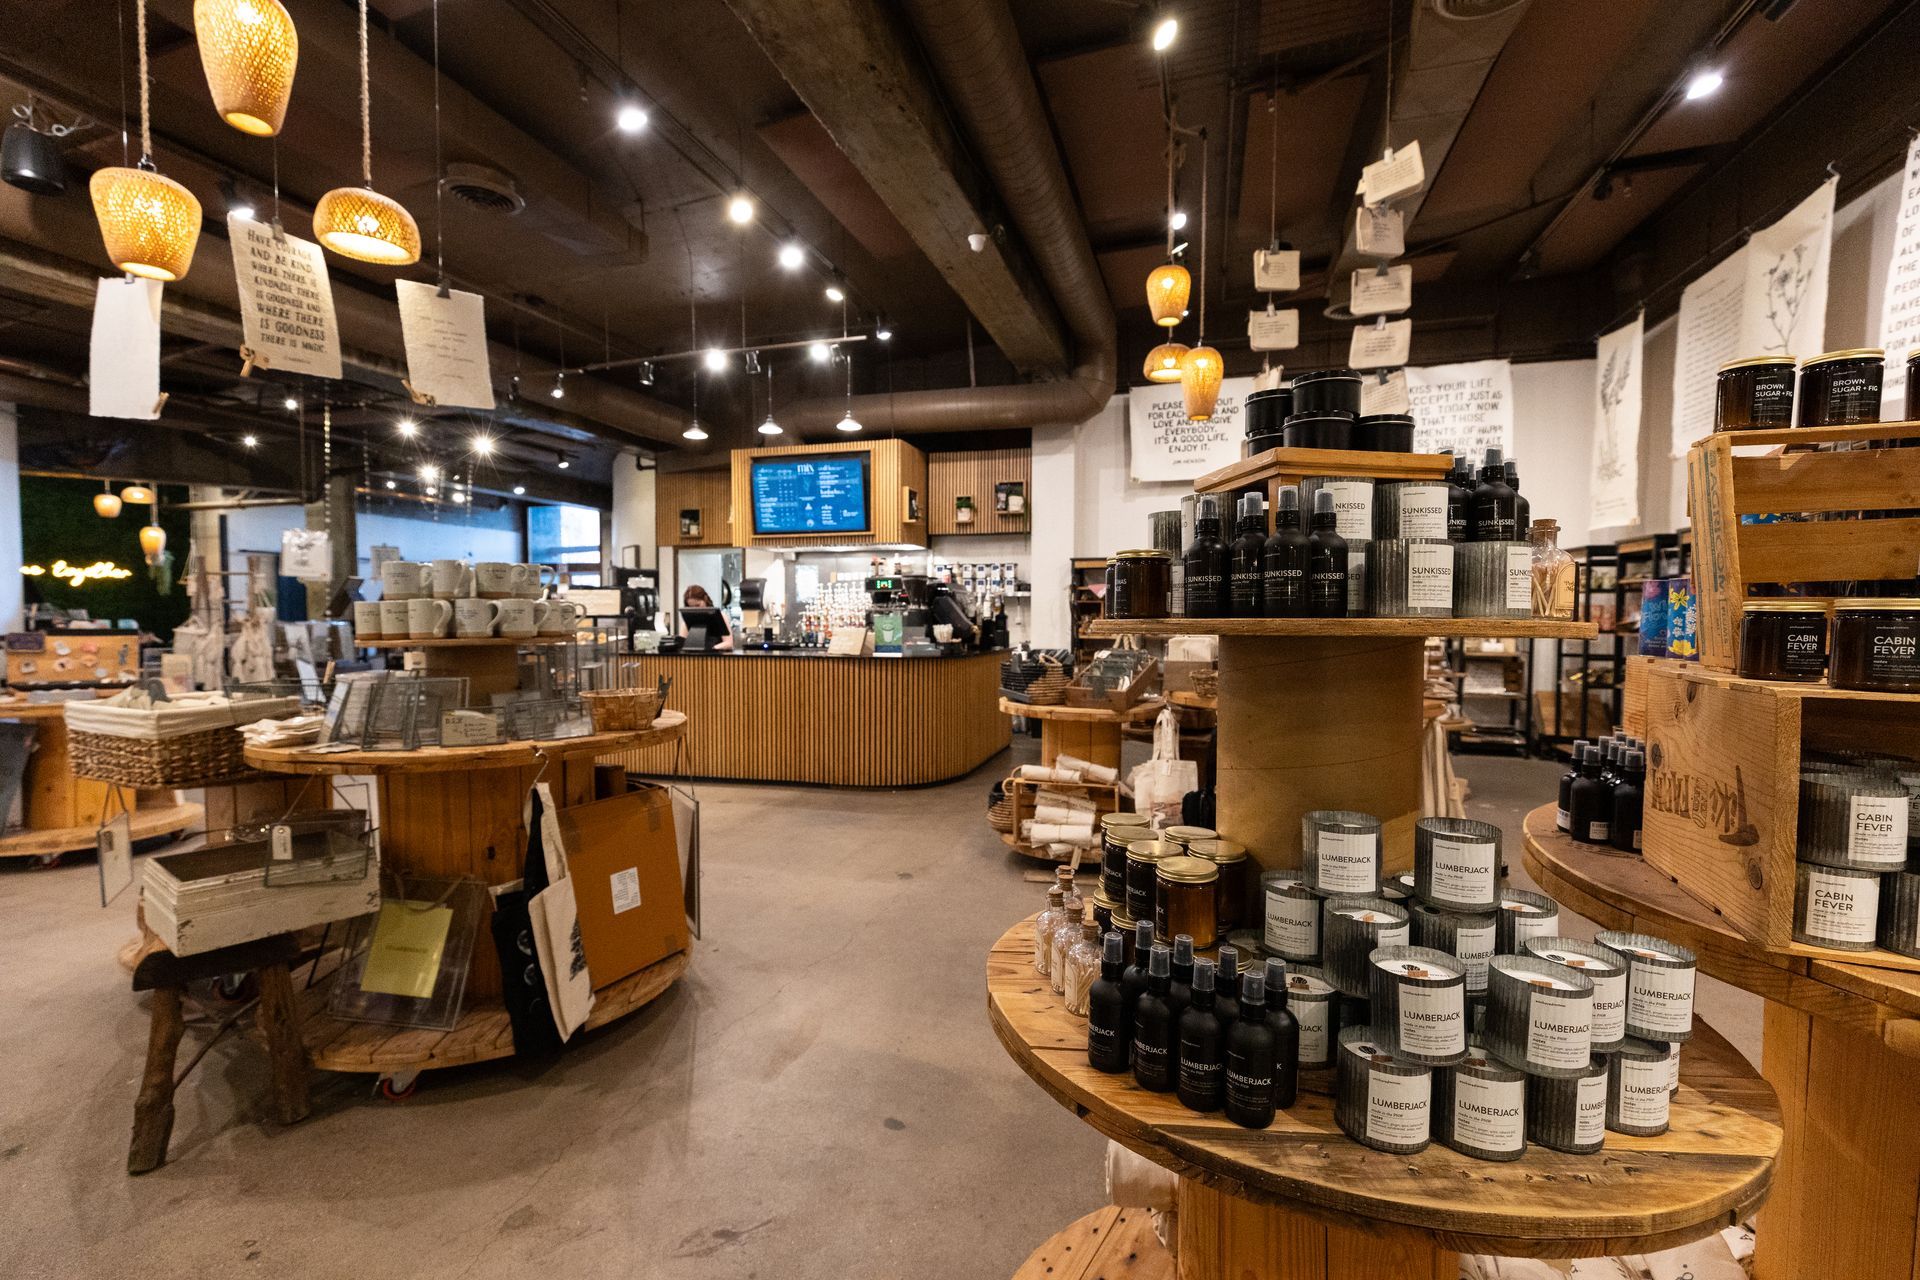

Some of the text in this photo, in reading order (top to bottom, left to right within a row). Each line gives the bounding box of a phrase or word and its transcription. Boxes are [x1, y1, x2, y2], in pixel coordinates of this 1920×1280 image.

[250, 248, 271, 261] AND
[275, 254, 286, 266] BE
[252, 262, 277, 277] WHERE
[282, 270, 305, 284] THERE
[296, 287, 320, 300] THERE
[256, 289, 320, 313] IS GOODNESS AND
[257, 302, 324, 327] WHERE THERE
[260, 318, 325, 341] IS GOODNESS
[260, 333, 286, 347] THERE
[289, 340, 297, 348] IS
[1409, 378, 1493, 395] KISS YOUR LIFE
[1755, 383, 1785, 391] BROWN
[1832, 378, 1866, 387] BROWN
[1456, 392, 1464, 400] IT
[1469, 391, 1490, 400] JUST
[1492, 390, 1503, 399] AS
[1755, 390, 1781, 398] SUGAR
[1832, 385, 1861, 394] SUGAR
[1152, 398, 1233, 410] PLEASE OUT
[1420, 406, 1431, 416] IS
[1439, 403, 1471, 414] TODAY
[1477, 402, 1500, 410] NOW
[1148, 412, 1164, 420] FOR
[1422, 414, 1485, 426] THAT THOSE
[1153, 420, 1174, 428] LOVE
[1176, 418, 1193, 426] AND
[1165, 426, 1217, 435] EVERYBODY.
[1154, 435, 1169, 445] IT'S
[1180, 434, 1205, 443] GOOD
[1168, 444, 1197, 453] ENJOY
[1335, 502, 1366, 510] NKISSED
[1402, 507, 1443, 515] SUNKISSED
[1478, 519, 1516, 527] SUNKISSED
[1264, 569, 1303, 578] SUNKISSED
[1311, 572, 1345, 580] NKISSED
[1412, 567, 1451, 575] SUNKISSED
[1787, 634, 1818, 642] CABIN
[1873, 636, 1916, 645] CABIN
[1787, 642, 1818, 651] FEVER
[1873, 645, 1916, 655] FEVER
[1856, 813, 1893, 822] CABIN
[1856, 822, 1893, 832] FEVER
[1321, 853, 1371, 864] LUMBERJACK
[1435, 861, 1490, 874] LUMBERJACK
[1815, 889, 1853, 901] CABIN
[1814, 898, 1853, 912] FEVER
[1267, 912, 1313, 928] LUMBERJACK
[1460, 950, 1495, 960] LUMBERJA
[1634, 986, 1692, 1001] LUMBERJACK
[1592, 999, 1625, 1010] MBERJACK
[1404, 1010, 1461, 1022] LUMBERJACK
[1298, 1025, 1323, 1033] RJACK
[1534, 1020, 1590, 1034] LUMBERJACK
[1226, 1069, 1272, 1086] LUMBERJACK
[1372, 1096, 1428, 1111] LUMBERJACK
[1459, 1099, 1519, 1117] LUMBERJACK
